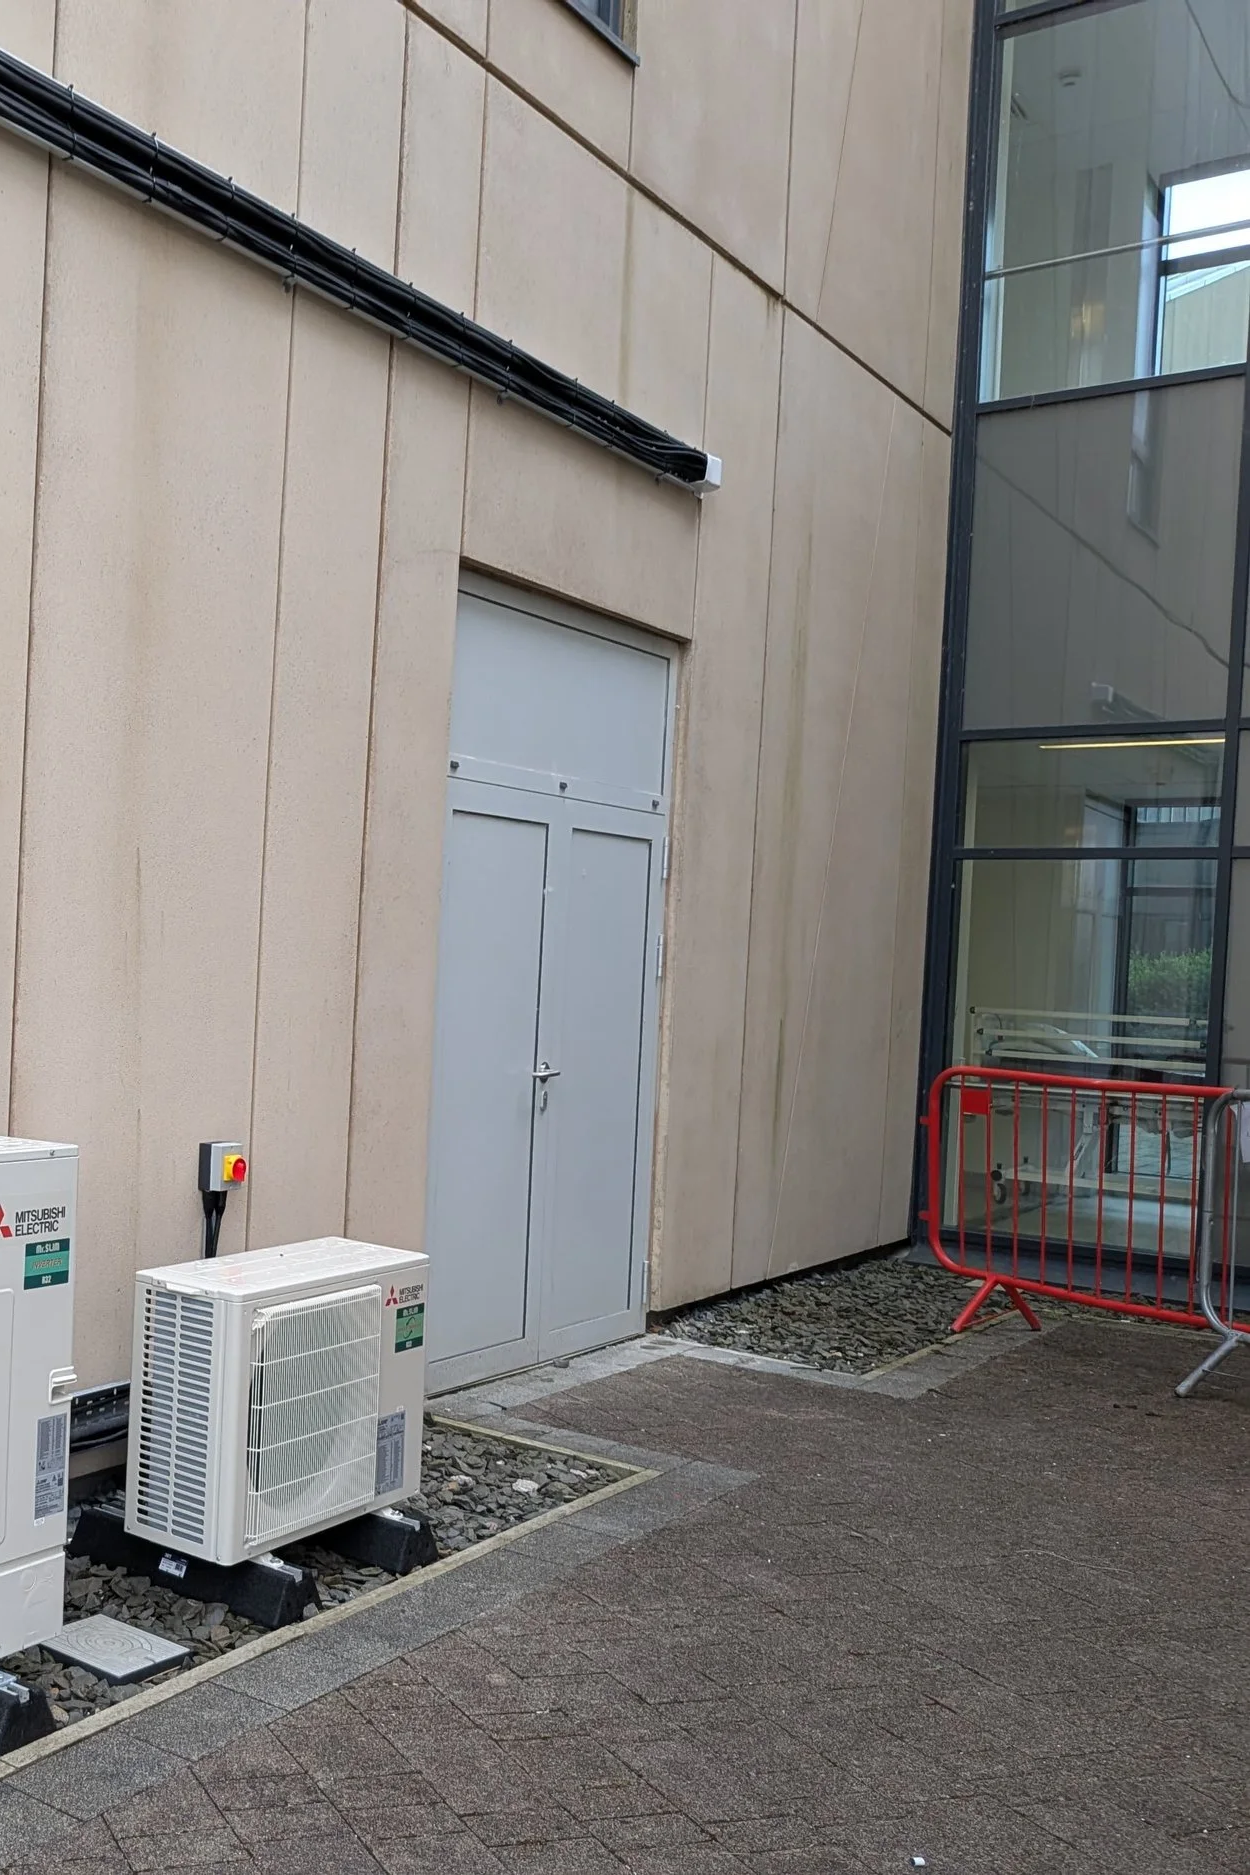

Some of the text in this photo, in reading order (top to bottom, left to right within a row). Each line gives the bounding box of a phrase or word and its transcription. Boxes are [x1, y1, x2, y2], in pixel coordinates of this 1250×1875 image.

[15, 1206, 66, 1224] MITSUBISHI
[15, 1220, 59, 1237] ELECTRIC
[399, 1284, 424, 1295] MITSUBISHI
[399, 1293, 420, 1304] ELECTRIC
